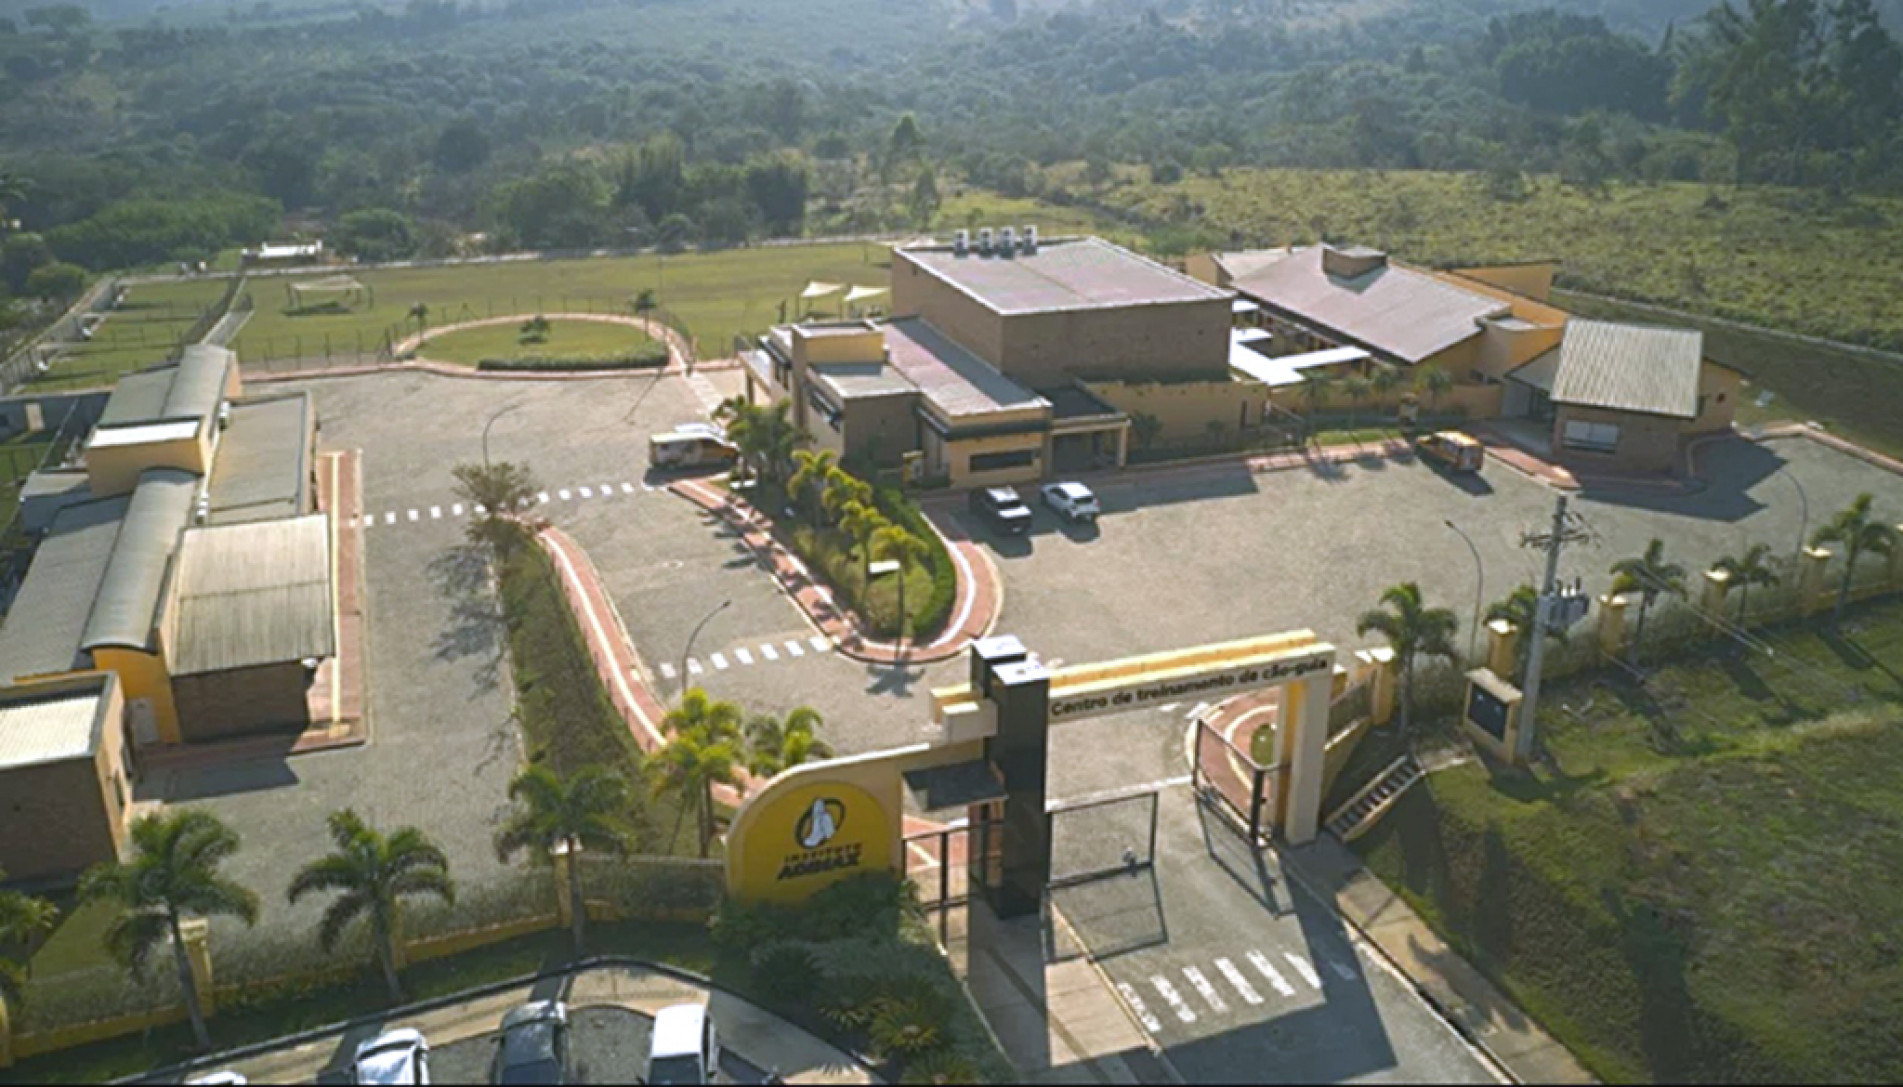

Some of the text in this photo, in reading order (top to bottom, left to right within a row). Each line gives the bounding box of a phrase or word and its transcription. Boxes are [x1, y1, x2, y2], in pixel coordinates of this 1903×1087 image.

[1051, 694, 1108, 717] Centro
[1112, 689, 1133, 705] de
[1136, 672, 1235, 699] treinamento
[1239, 667, 1258, 683] de
